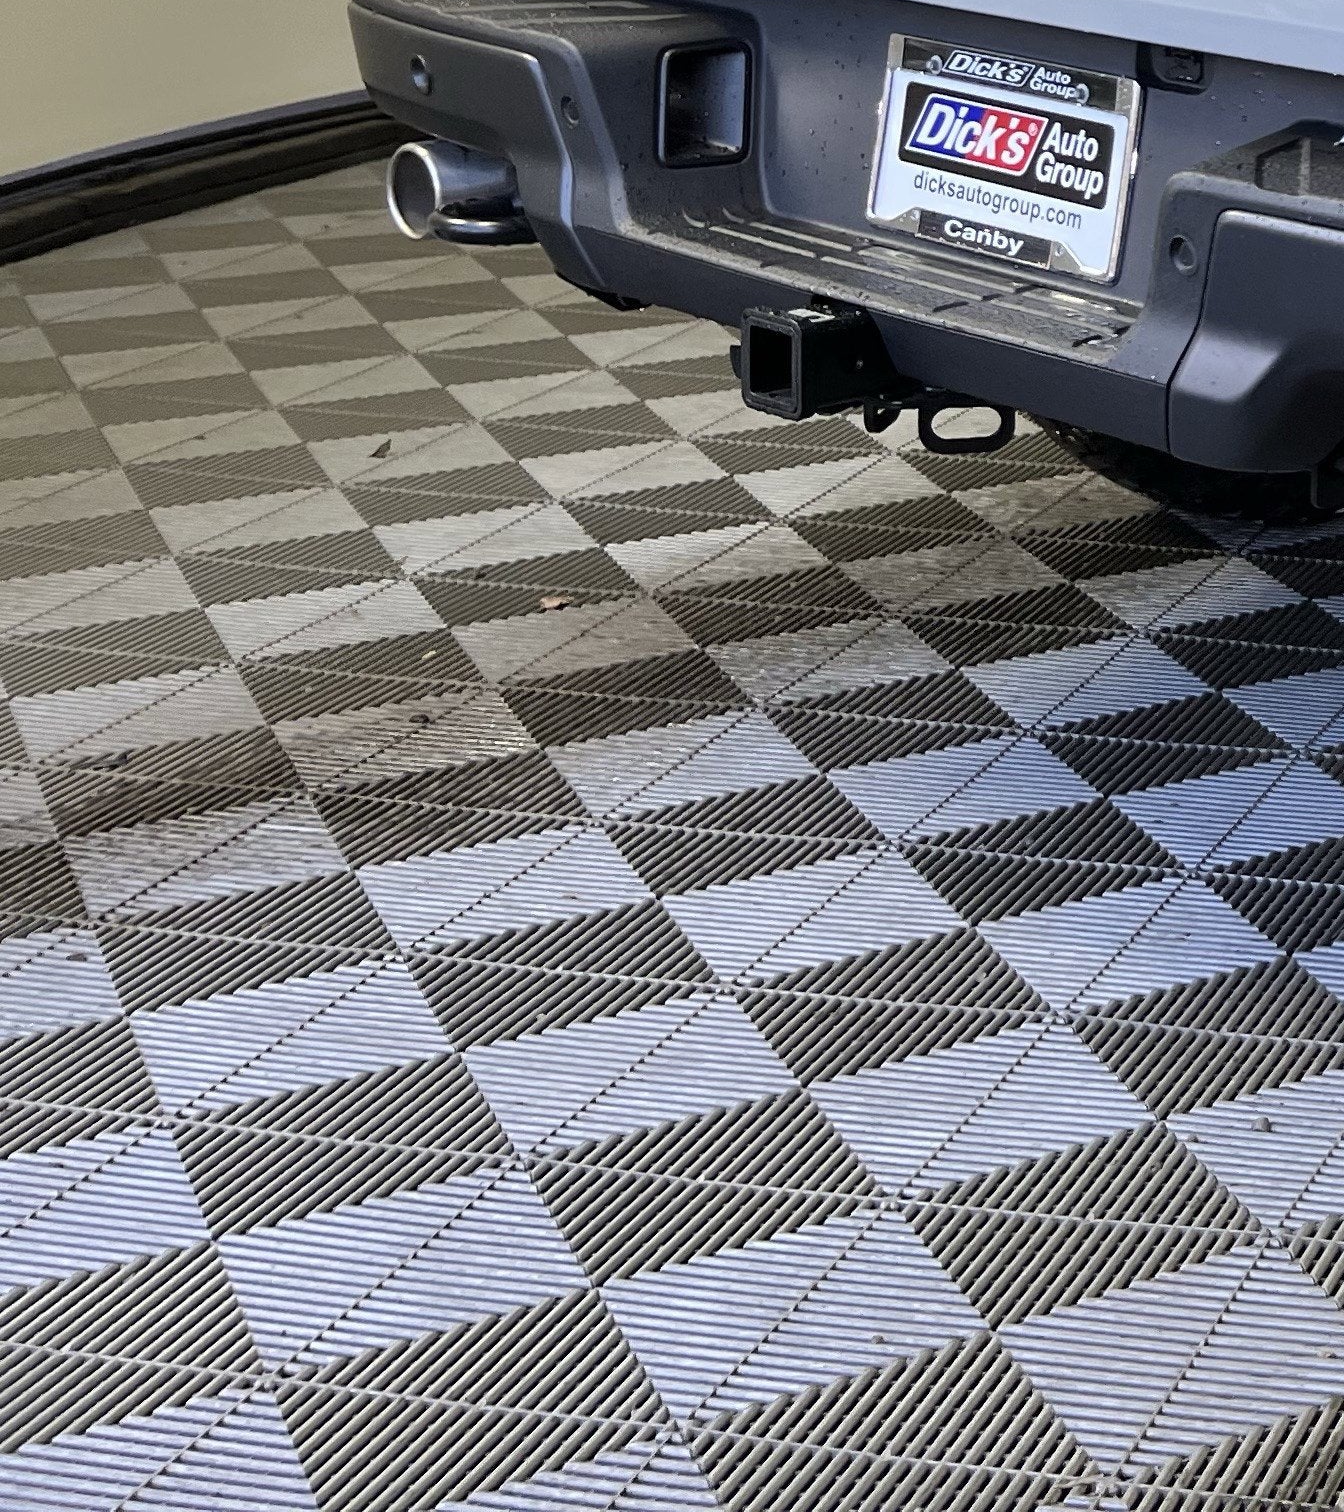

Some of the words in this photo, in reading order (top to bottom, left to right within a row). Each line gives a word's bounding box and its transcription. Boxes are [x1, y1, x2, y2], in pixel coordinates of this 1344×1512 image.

[949, 53, 1026, 85] Dick's
[1034, 66, 1072, 84] Auto
[1029, 79, 1077, 100] Group
[915, 101, 1032, 166] Dick's
[1042, 121, 1099, 162] Auto
[1035, 152, 1104, 200] Group
[913, 170, 1082, 230] dicksautogroup.com
[943, 218, 1025, 257] Canby
